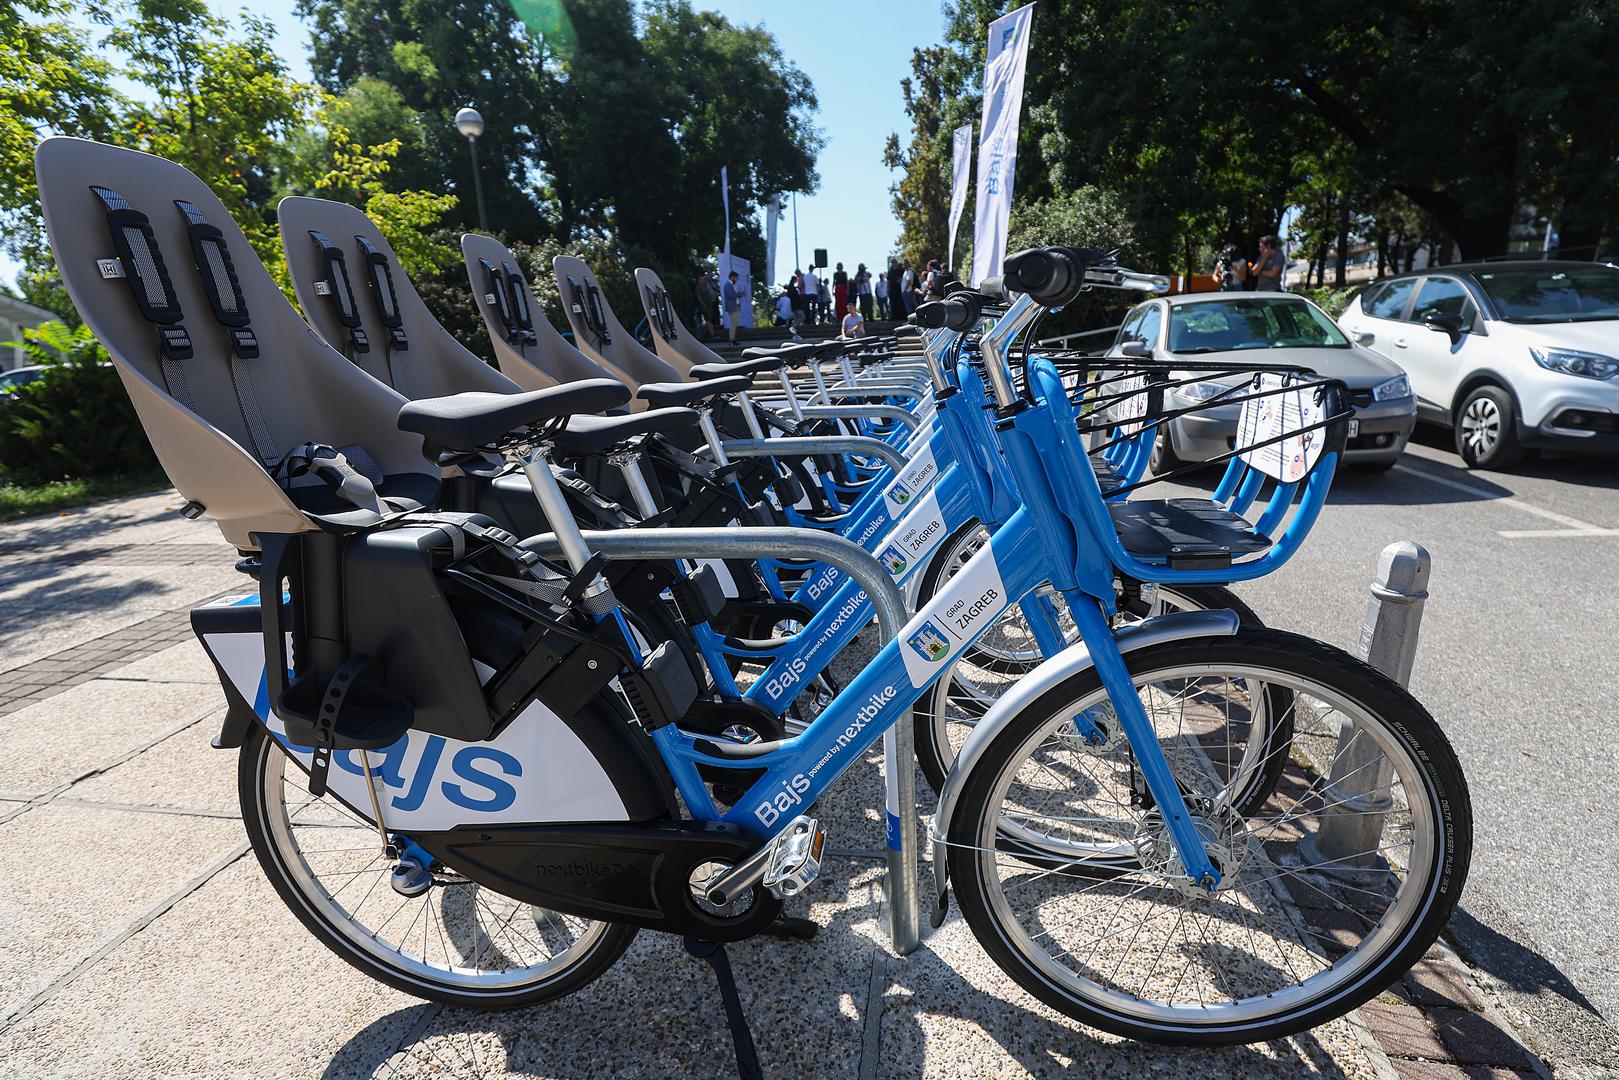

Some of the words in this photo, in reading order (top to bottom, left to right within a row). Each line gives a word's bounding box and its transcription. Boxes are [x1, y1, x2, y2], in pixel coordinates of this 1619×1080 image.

[911, 463, 934, 487] ZAGREB
[856, 514, 885, 547] extbike
[902, 528, 917, 543] GRAD
[909, 520, 940, 551] ZAGREB
[807, 565, 839, 601] Bajs
[945, 599, 965, 618] GRAD
[955, 588, 998, 630] ZAGREB
[765, 657, 806, 701] Bajs
[804, 640, 822, 661] powered
[824, 590, 868, 638] nextbike
[754, 773, 811, 829] Bajs
[808, 751, 833, 777] powered
[829, 744, 841, 757] by
[836, 685, 897, 748] nextbike
[1395, 721, 1430, 761] SCHWALBE
